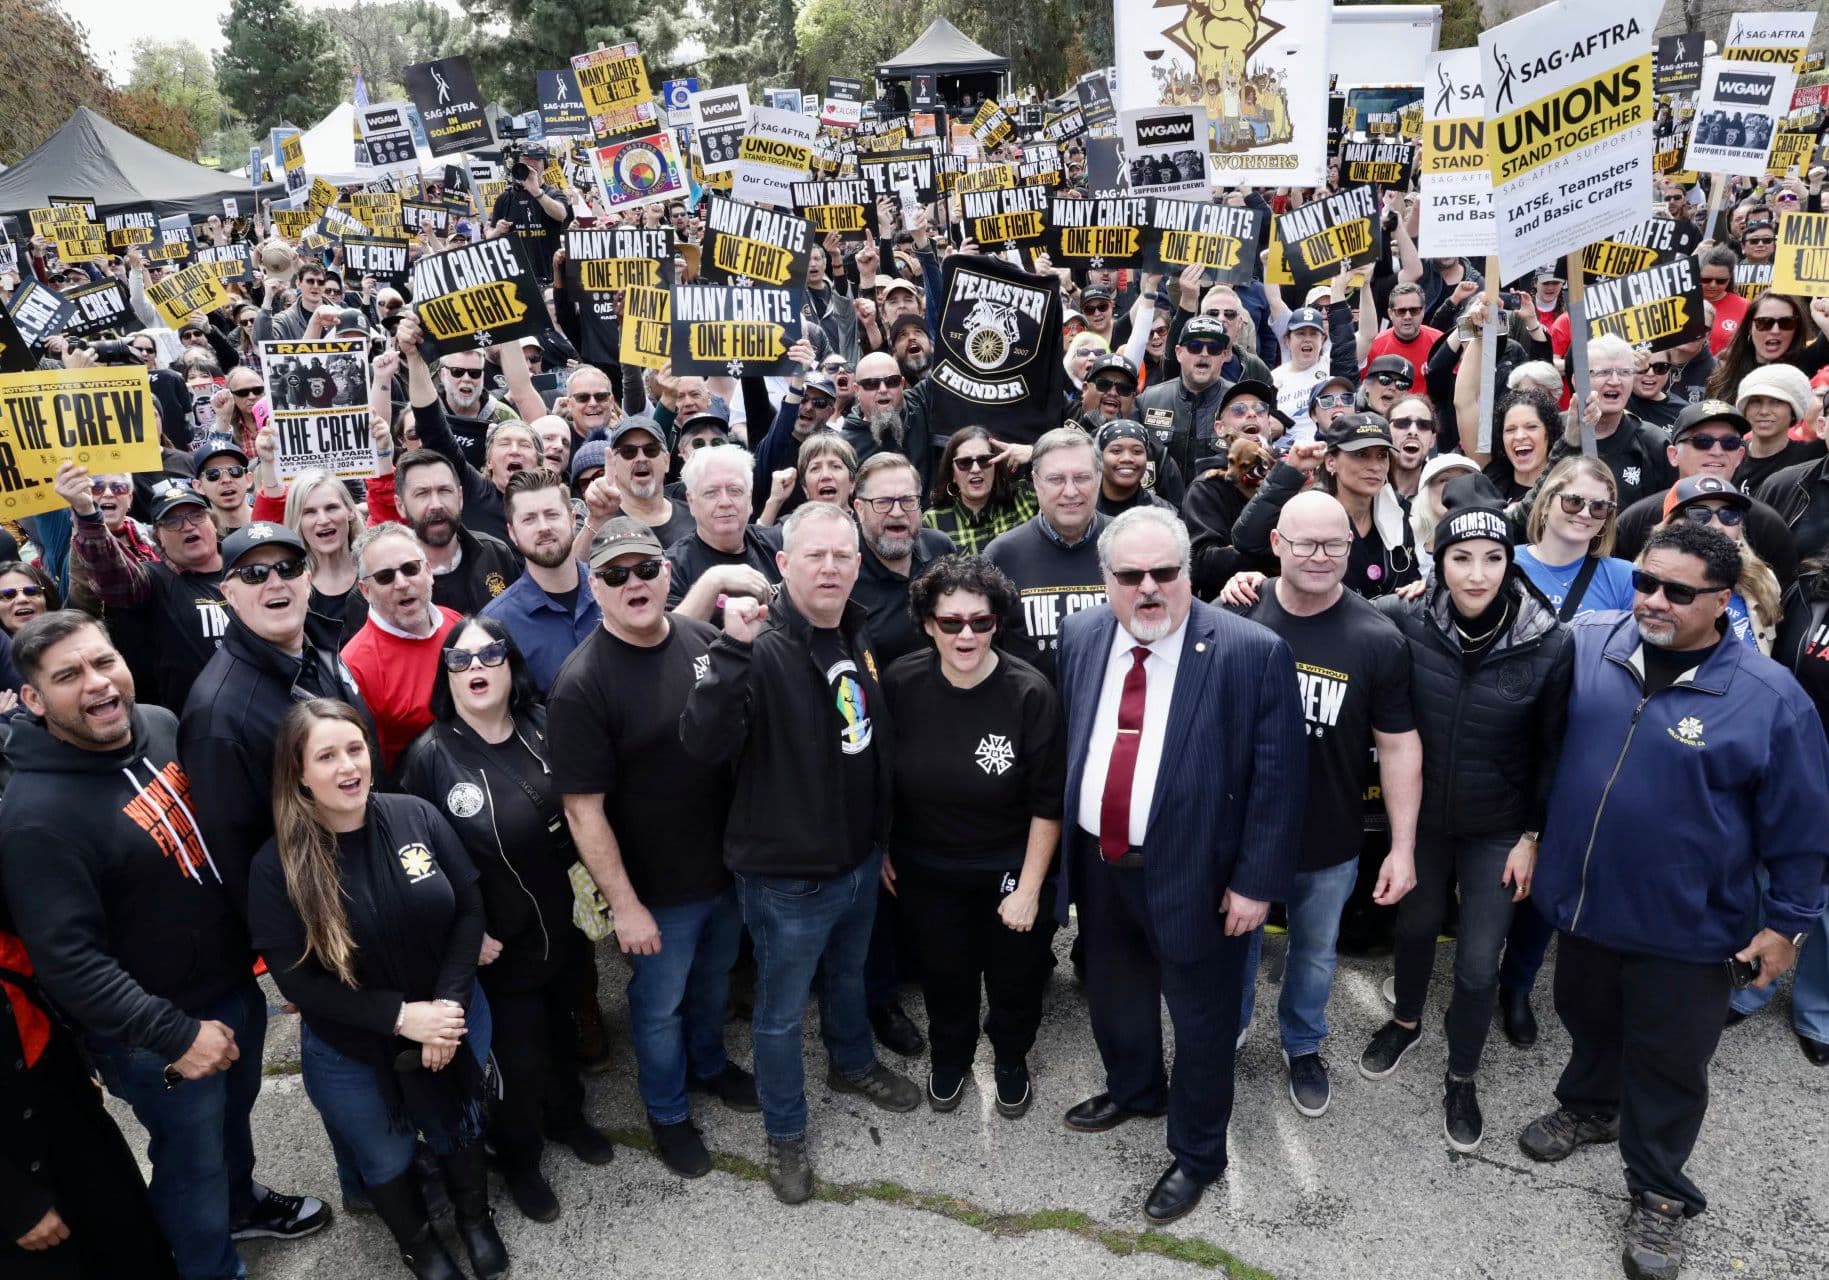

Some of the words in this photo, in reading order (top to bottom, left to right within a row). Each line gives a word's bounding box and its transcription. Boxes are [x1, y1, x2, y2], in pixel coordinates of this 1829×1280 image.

[1726, 49, 1800, 64] UNIONS
[578, 65, 606, 88] MANY
[1660, 73, 1698, 83] SOLIDARITY
[593, 83, 612, 105] ONE
[1719, 80, 1771, 97] WGAW
[368, 114, 398, 126] WGAW
[544, 115, 586, 123] SOLIDARITY
[703, 102, 738, 115] WGAW
[1497, 64, 1642, 155] UNIONS
[430, 119, 482, 138] SOLIDARITY
[448, 117, 458, 125] IN
[1061, 112, 1084, 131] CREW
[1138, 122, 1192, 138] WGAW
[745, 138, 807, 162] UNIONS
[1345, 143, 1374, 162] MANY
[1500, 140, 1552, 178] STAND
[1554, 104, 1642, 154] TOGETHER
[1576, 127, 1643, 161] SUPPORTS
[1776, 135, 1810, 152] CRAFTS
[659, 136, 681, 188] PRIDE
[743, 152, 767, 161] STAND
[768, 156, 804, 170] TOGETHER
[1210, 154, 1299, 170] WORKERS
[1432, 154, 1484, 170] STAND
[1693, 146, 1727, 157] SUPPORTS
[1728, 150, 1741, 158] OUR
[1741, 151, 1765, 160] CREWS
[742, 174, 761, 184] Our
[861, 163, 886, 193] THE
[1020, 164, 1038, 178] MANY
[1353, 163, 1370, 180] ONE
[793, 182, 826, 206] MANY
[1133, 185, 1167, 195] SUPPORTS
[1168, 184, 1180, 193] OUR
[1182, 182, 1205, 192] CREWS
[1507, 192, 1554, 223] IATSE,
[1558, 157, 1640, 198] Teamsters
[353, 195, 371, 207] MANY
[964, 193, 999, 218] MANY
[1432, 194, 1481, 207] IATSE,
[1514, 217, 1540, 238] and
[1543, 199, 1584, 224] Basic
[1587, 178, 1633, 205] Crafts
[106, 216, 124, 232] MANY
[403, 207, 418, 227] THE
[808, 208, 827, 230] ONE
[1053, 200, 1094, 227] MANY
[1097, 200, 1149, 227] CRAFTS.
[1153, 201, 1197, 230] MANY
[1200, 205, 1254, 240] CRAFTS.
[1280, 208, 1326, 244] MANY
[1327, 185, 1377, 225] CRAFTS.
[1437, 210, 1465, 222] and
[56, 227, 80, 241] MANY
[709, 197, 751, 236] MANY
[751, 208, 807, 254] CRAFTS.
[981, 215, 1001, 241] ONE
[1784, 215, 1829, 246] MAN
[113, 232, 127, 245] ONE
[569, 231, 613, 260] MANY
[615, 230, 671, 259] CRAFTS.
[1067, 230, 1092, 254] ONE
[1166, 233, 1196, 263] ONE
[1307, 232, 1337, 267] ONE
[198, 247, 214, 262] MANY
[344, 245, 366, 269] THE
[368, 246, 406, 271] CREW
[454, 239, 525, 291] CRAFTS.
[718, 234, 741, 269] ONE
[743, 242, 784, 282] FIGHT.
[147, 280, 178, 305] MANY
[175, 264, 210, 292] CRAFTS
[587, 261, 613, 288] ONE
[1628, 259, 1697, 305] CRAFTS.
[16, 284, 61, 331] CREW
[79, 287, 125, 320] CREW
[426, 301, 468, 337] ONE
[470, 283, 523, 330] FIGHT.
[593, 302, 613, 314] ONE
[628, 288, 668, 320] MANY
[676, 287, 727, 321] MANY
[732, 289, 796, 324] CRAFTS.
[954, 272, 1046, 325] TEAMSTER
[1303, 309, 1314, 321] S
[1598, 313, 1633, 342] ONE
[1634, 299, 1683, 341] FIGHT.
[277, 342, 352, 353] RALLY
[638, 323, 664, 352] ONE
[697, 324, 727, 357] ONE
[732, 324, 778, 358] FIGHT.
[950, 332, 963, 340] EST
[2, 385, 40, 395] NOTHING
[41, 382, 83, 391] MOVES
[83, 379, 141, 389] WITHOUT
[939, 364, 1025, 400] THUNDER
[5, 396, 52, 450] THE
[53, 390, 144, 448] CREW
[275, 418, 313, 456] THE
[316, 413, 370, 453] CREW
[279, 453, 338, 463] WOODLEY
[342, 449, 373, 457] PARK
[331, 455, 374, 463] CALIFORNIA
[337, 461, 355, 469] 2024
[1450, 511, 1507, 538] TEAMSTERS
[1462, 530, 1486, 540] LOCAL
[1021, 594, 1060, 637] THE
[1304, 665, 1348, 680] WITHOUT
